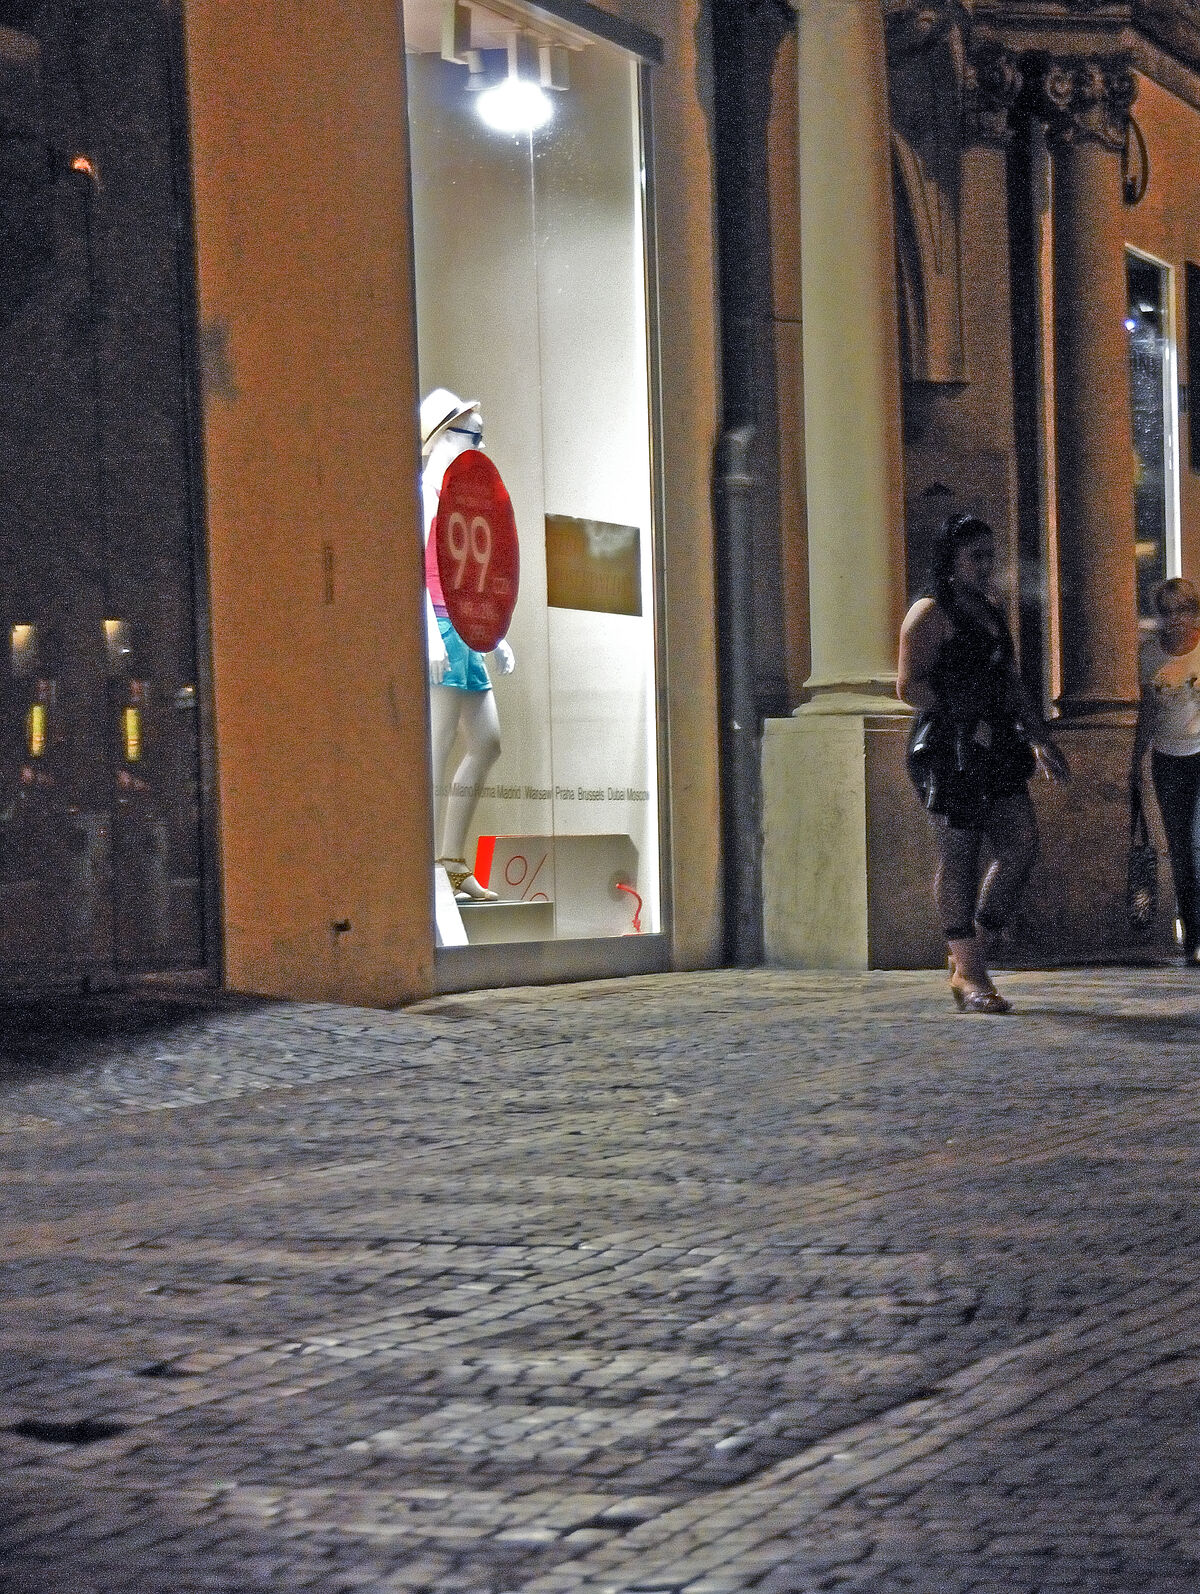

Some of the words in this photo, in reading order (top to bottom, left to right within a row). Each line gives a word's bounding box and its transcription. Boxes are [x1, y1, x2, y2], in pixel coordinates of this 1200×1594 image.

[448, 512, 491, 592] 99
[555, 785, 575, 800] Praha
[578, 786, 605, 801] Brussels
